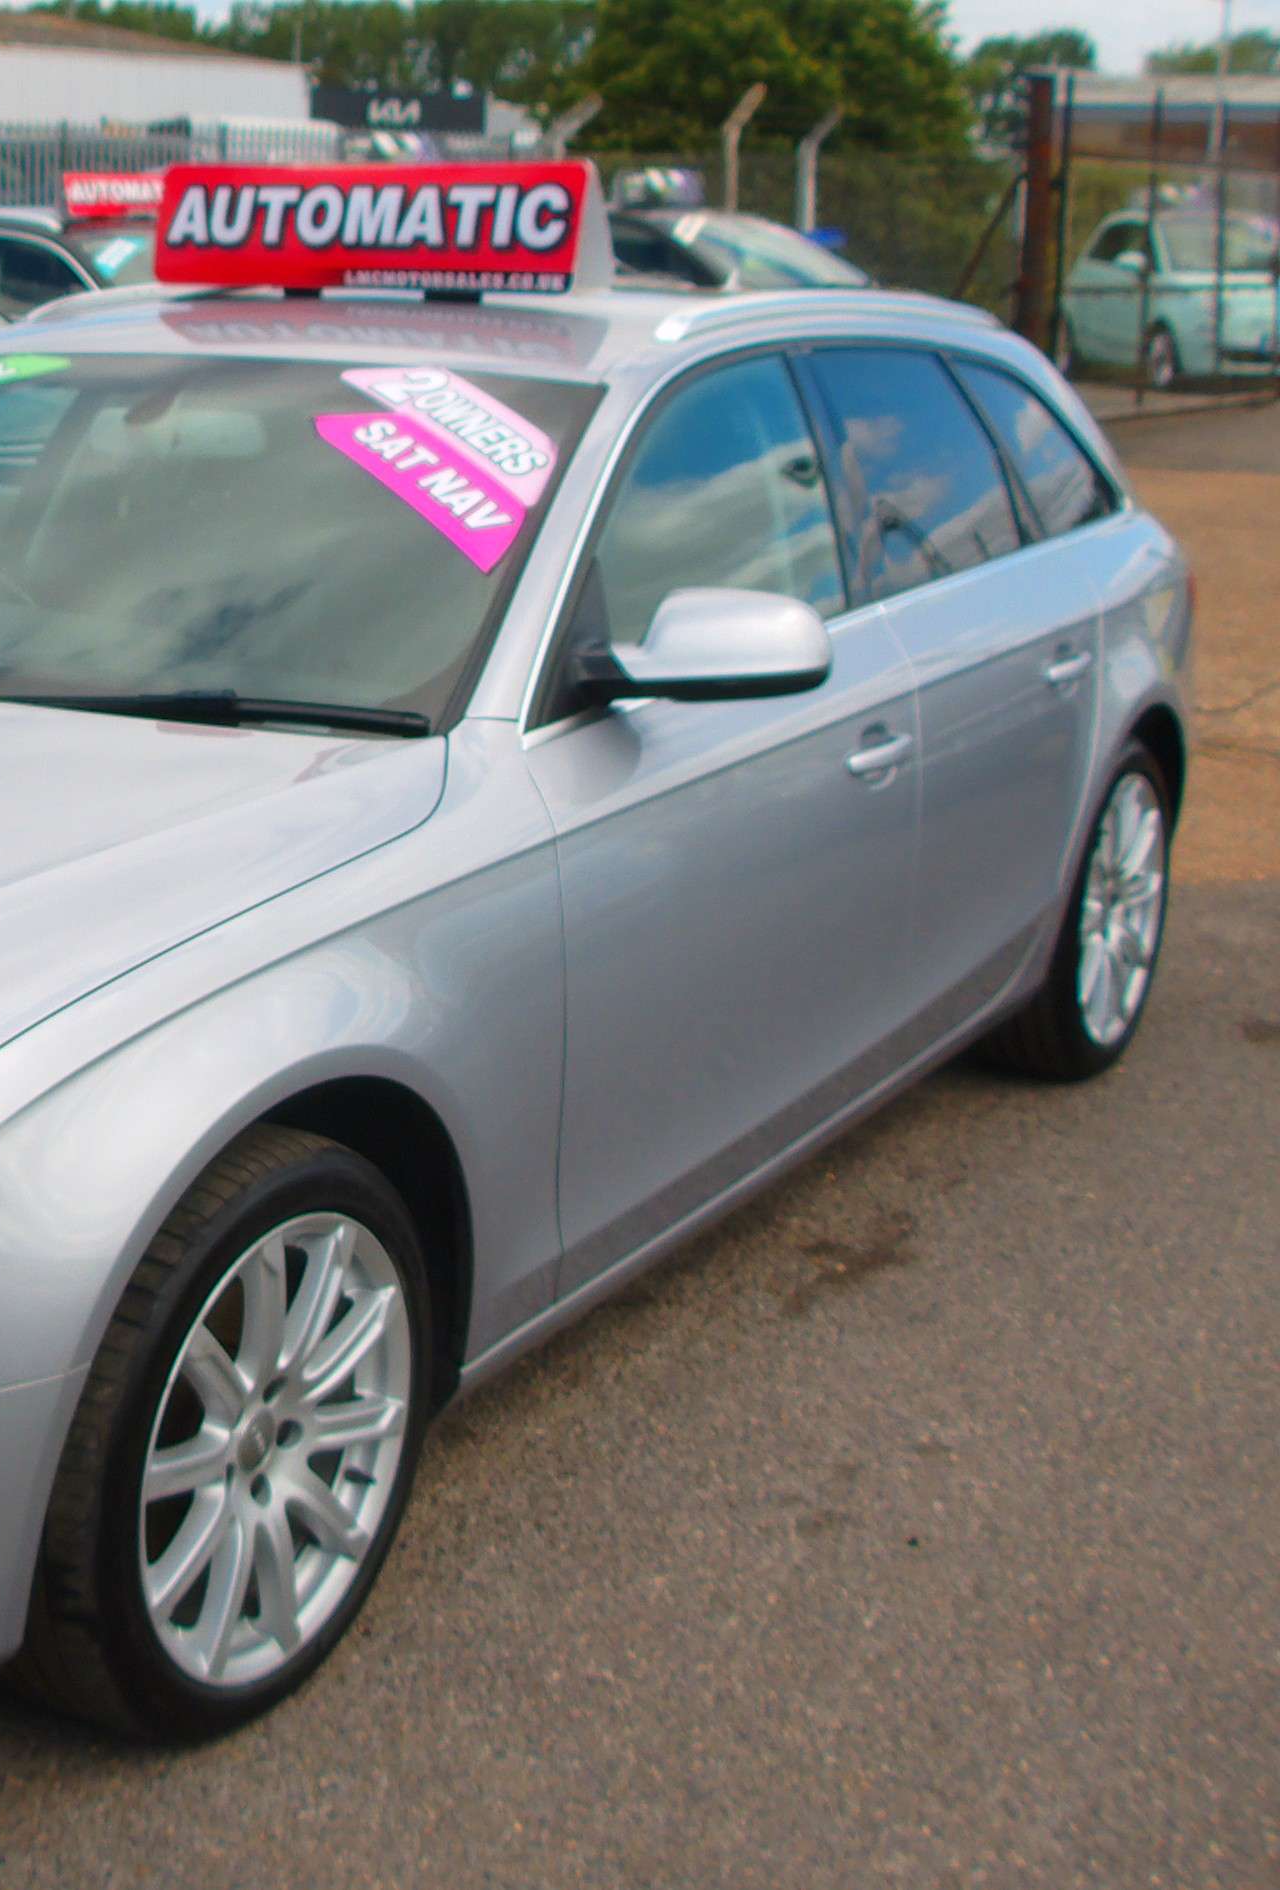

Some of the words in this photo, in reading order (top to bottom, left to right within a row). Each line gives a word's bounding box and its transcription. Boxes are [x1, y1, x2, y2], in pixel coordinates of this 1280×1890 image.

[165, 183, 573, 254] AUTOMATIC
[352, 420, 441, 472] SAT
[416, 466, 514, 530] NAV
